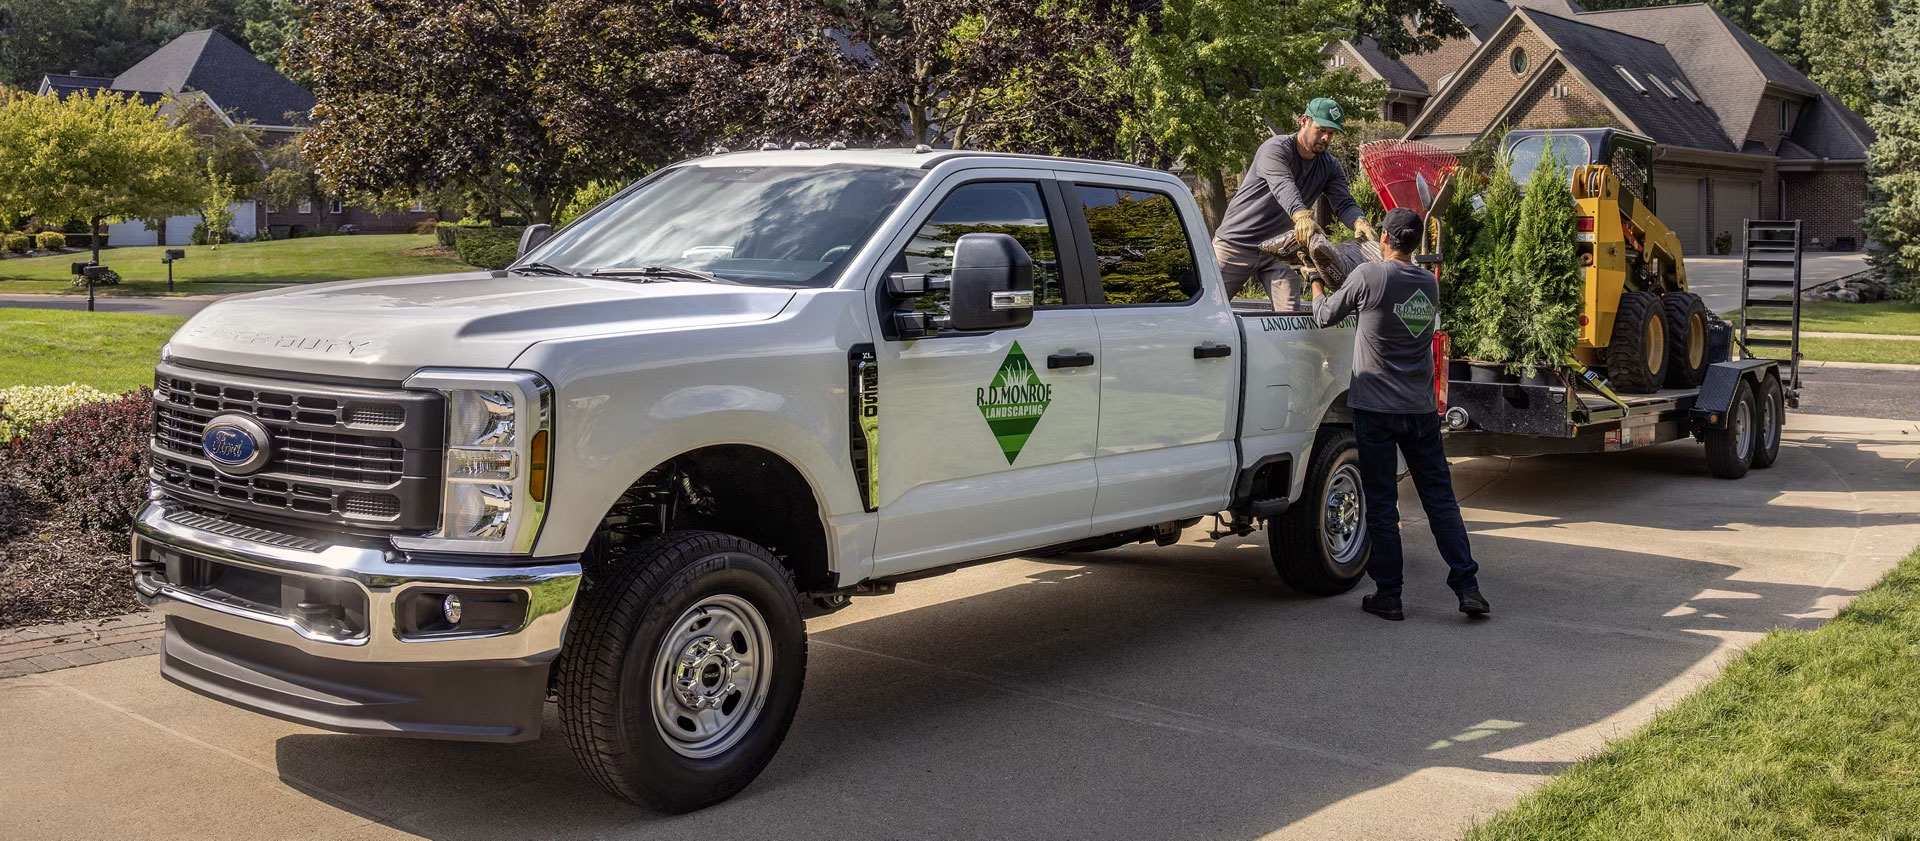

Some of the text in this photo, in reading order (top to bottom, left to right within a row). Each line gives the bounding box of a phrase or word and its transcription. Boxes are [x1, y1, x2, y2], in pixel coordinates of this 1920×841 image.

[1260, 317, 1319, 331] LANDSCAPIN
[985, 405, 1043, 418] LANDSCAPING
[212, 430, 244, 457] Ford
